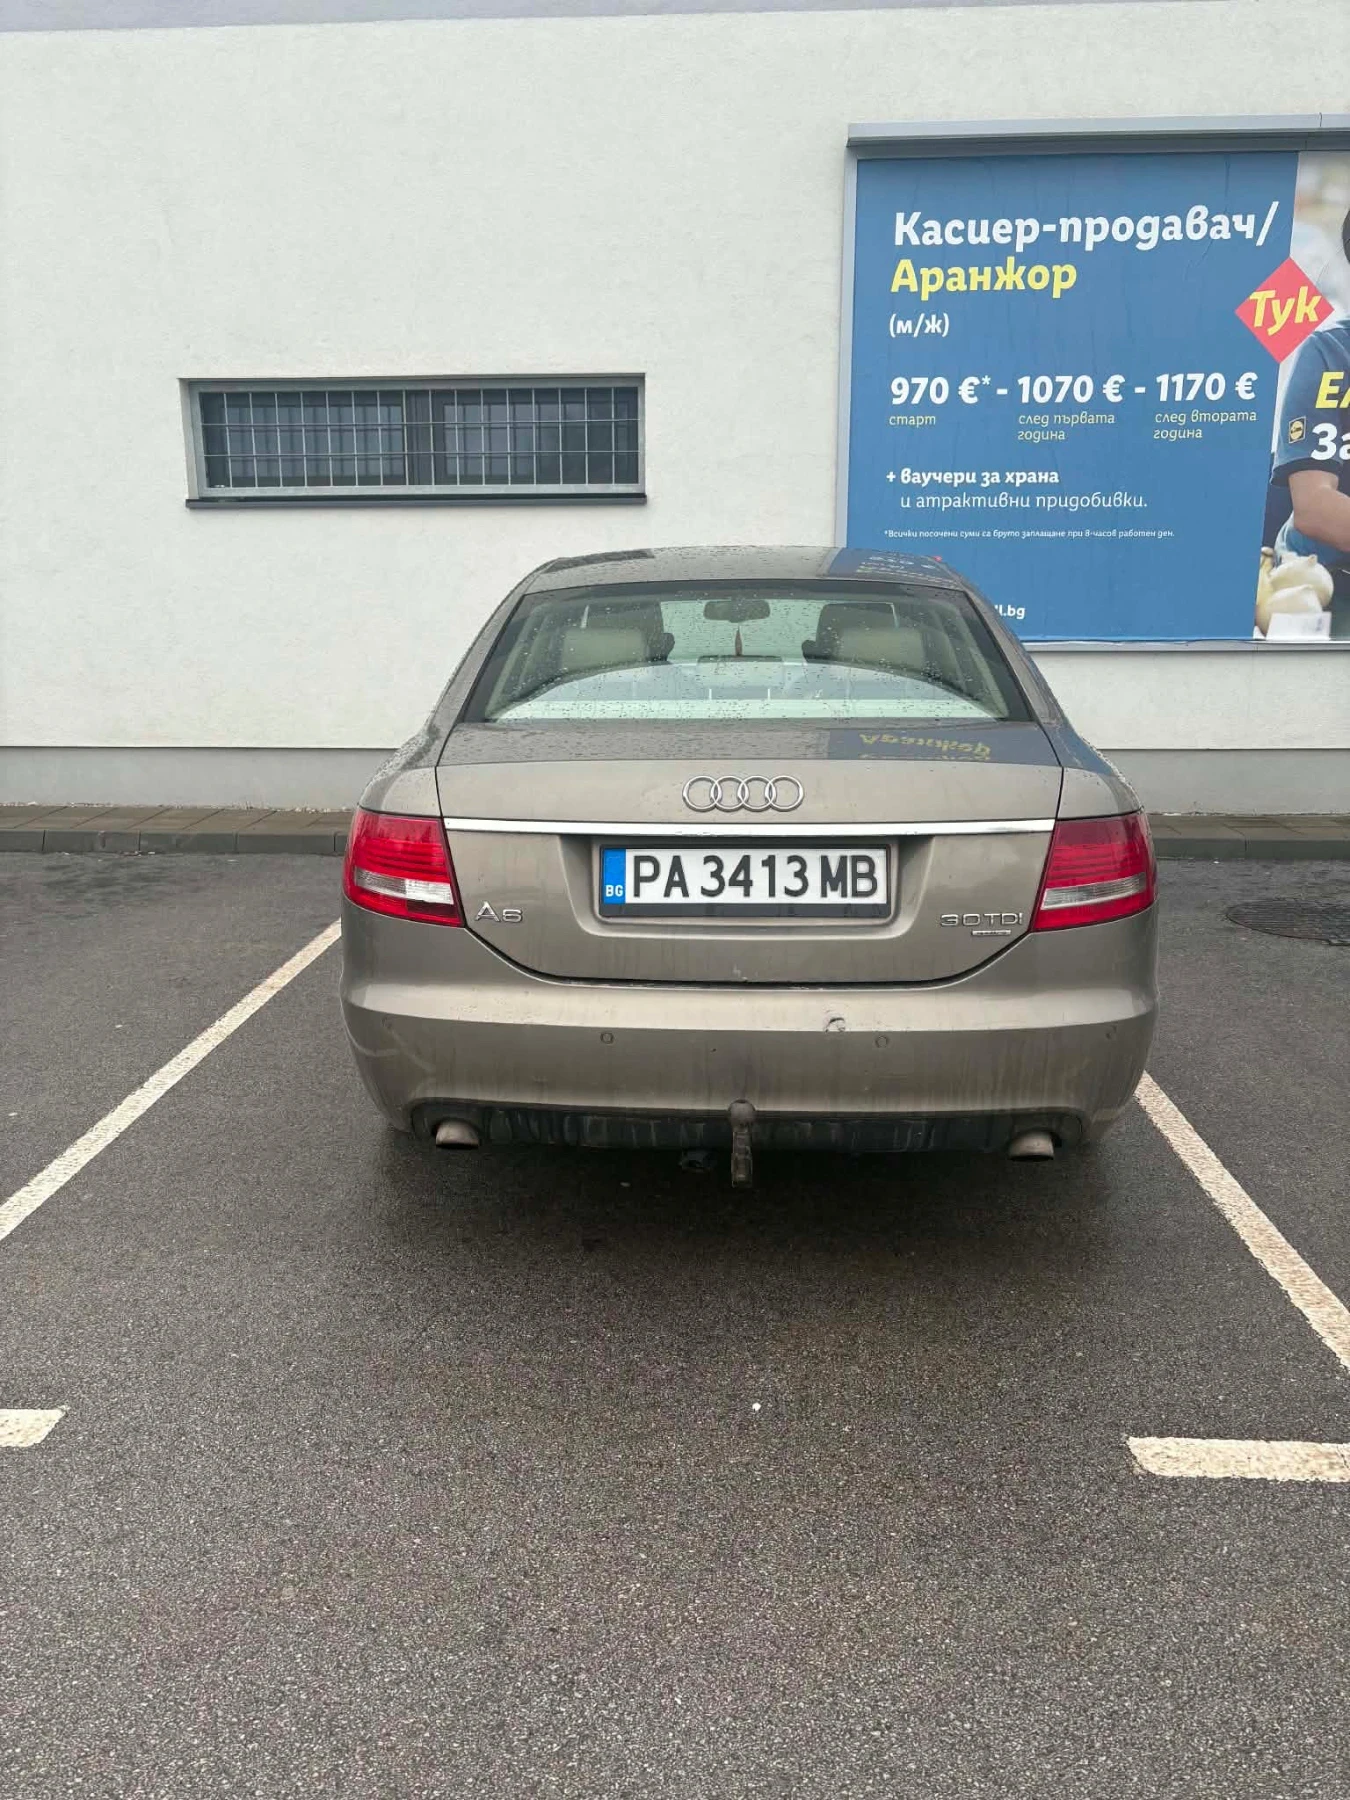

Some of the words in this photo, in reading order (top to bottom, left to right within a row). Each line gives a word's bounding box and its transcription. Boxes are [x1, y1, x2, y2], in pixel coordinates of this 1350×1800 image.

[894, 201, 1280, 252] Касиер-продавач/
[890, 256, 1078, 302] Аранжор
[1249, 285, 1322, 336] Тук
[889, 312, 950, 338] (м/ж)
[890, 376, 950, 405] 970
[1017, 375, 1094, 404] 1070
[1102, 374, 1126, 403] €
[1156, 373, 1226, 402] 1170
[1235, 371, 1259, 400] €
[889, 415, 937, 427] старт
[1018, 412, 1050, 427] след
[1053, 410, 1116, 427] първата
[1155, 410, 1187, 425] след
[1190, 408, 1258, 426] втората
[1017, 430, 1066, 443] година
[1153, 428, 1203, 441] година
[886, 471, 897, 483] +
[900, 467, 977, 488] ваучери
[981, 471, 1001, 488] за
[1005, 471, 1060, 488] храна
[900, 496, 912, 508] и
[915, 491, 1031, 512] атрактивни
[1035, 490, 1148, 512] придобивки.
[959, 531, 980, 539] суми
[993, 529, 1020, 539] бруто
[1021, 530, 1066, 540] заплащане
[1067, 530, 1083, 539] при
[1118, 529, 1156, 539] работен
[633, 854, 690, 898] PA
[700, 854, 810, 898] 3413
[819, 854, 878, 898] MB
[605, 885, 624, 897] BG
[475, 900, 522, 922] A6
